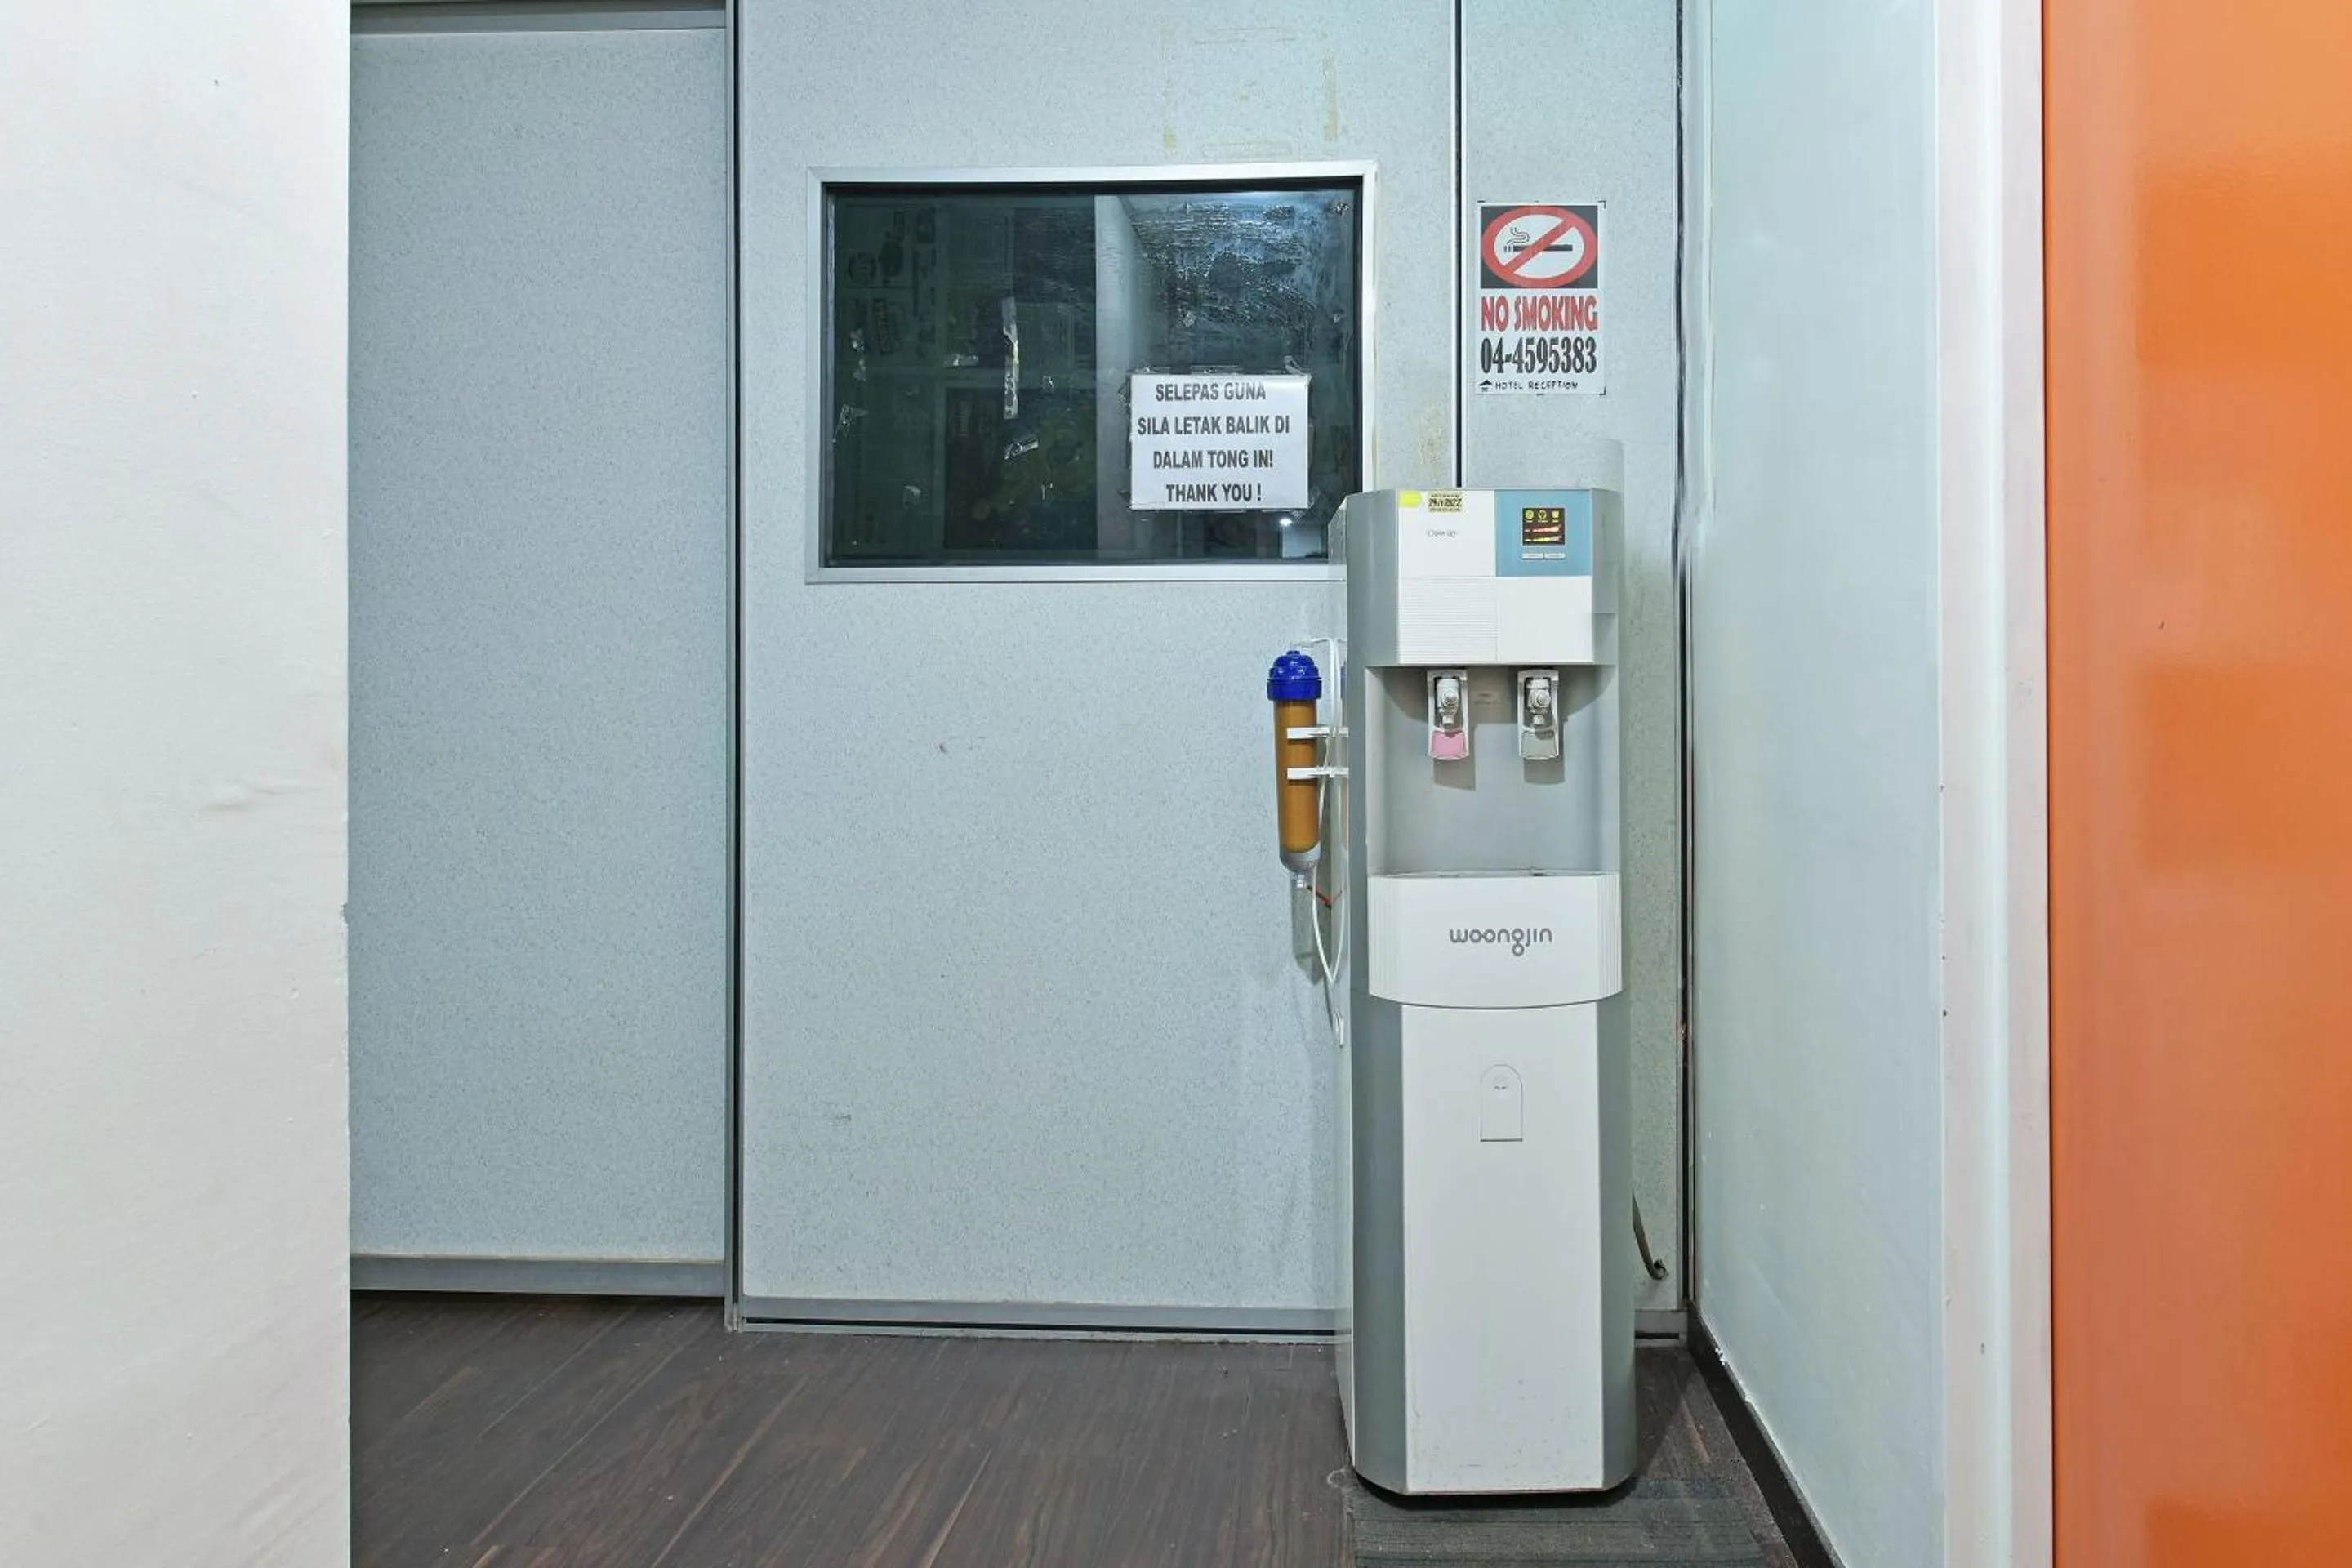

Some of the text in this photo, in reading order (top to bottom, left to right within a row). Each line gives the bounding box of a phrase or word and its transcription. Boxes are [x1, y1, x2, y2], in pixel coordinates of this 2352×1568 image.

[1481, 295, 1598, 332] NO SMOKING
[1480, 336, 1597, 374] 04-4595383
[1155, 382, 1267, 402] SELEPAS GUNA
[1495, 381, 1578, 390] HOTEL RECEPTION
[1138, 415, 1290, 435] SILA LETAK BALIK DI
[1153, 449, 1273, 469] DALAM TONG IN!
[1166, 484, 1217, 502] THANK
[1221, 483, 1252, 501] YOU
[1450, 928, 1552, 957] woongjin
